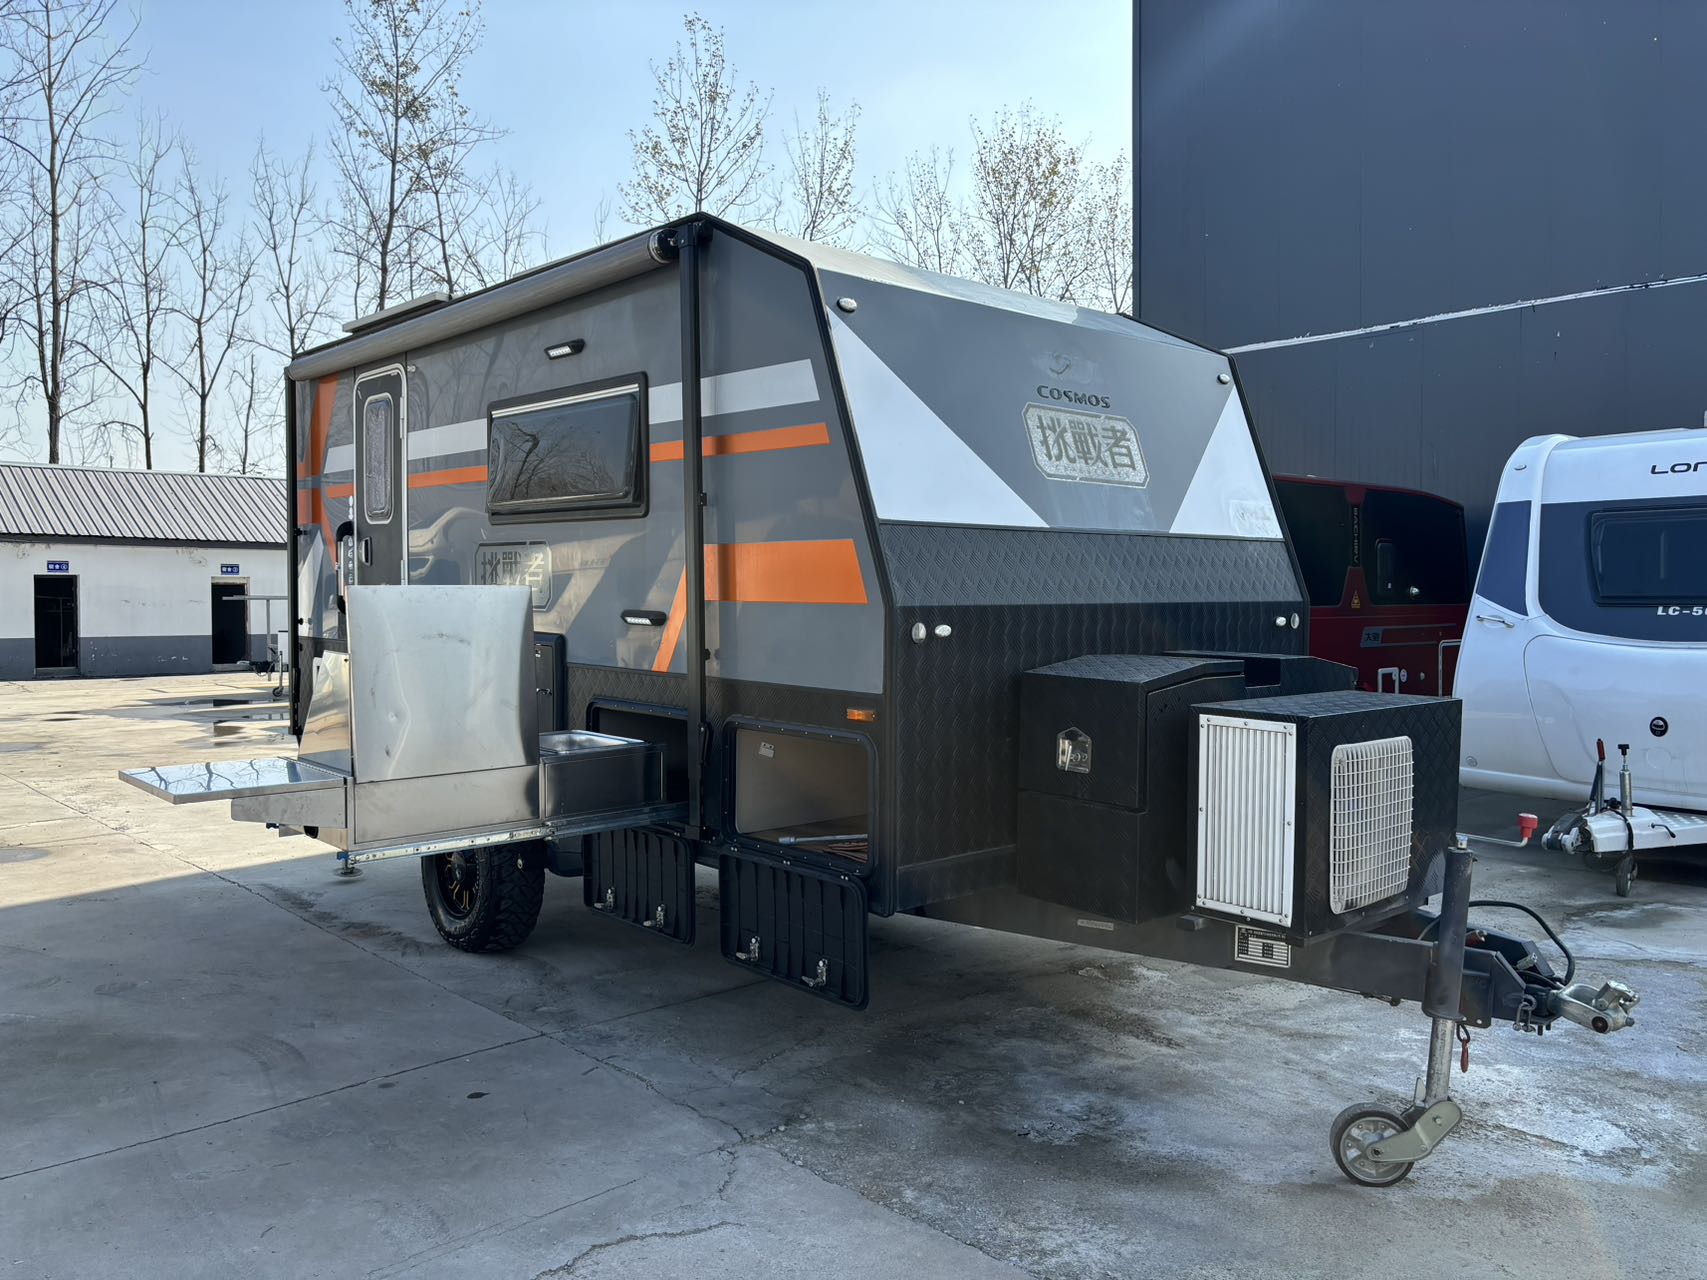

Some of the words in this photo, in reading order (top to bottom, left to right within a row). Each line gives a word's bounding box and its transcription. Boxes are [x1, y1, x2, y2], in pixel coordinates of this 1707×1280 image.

[1036, 385, 1111, 409] COSMOS
[1037, 414, 1137, 471] 挑戰者
